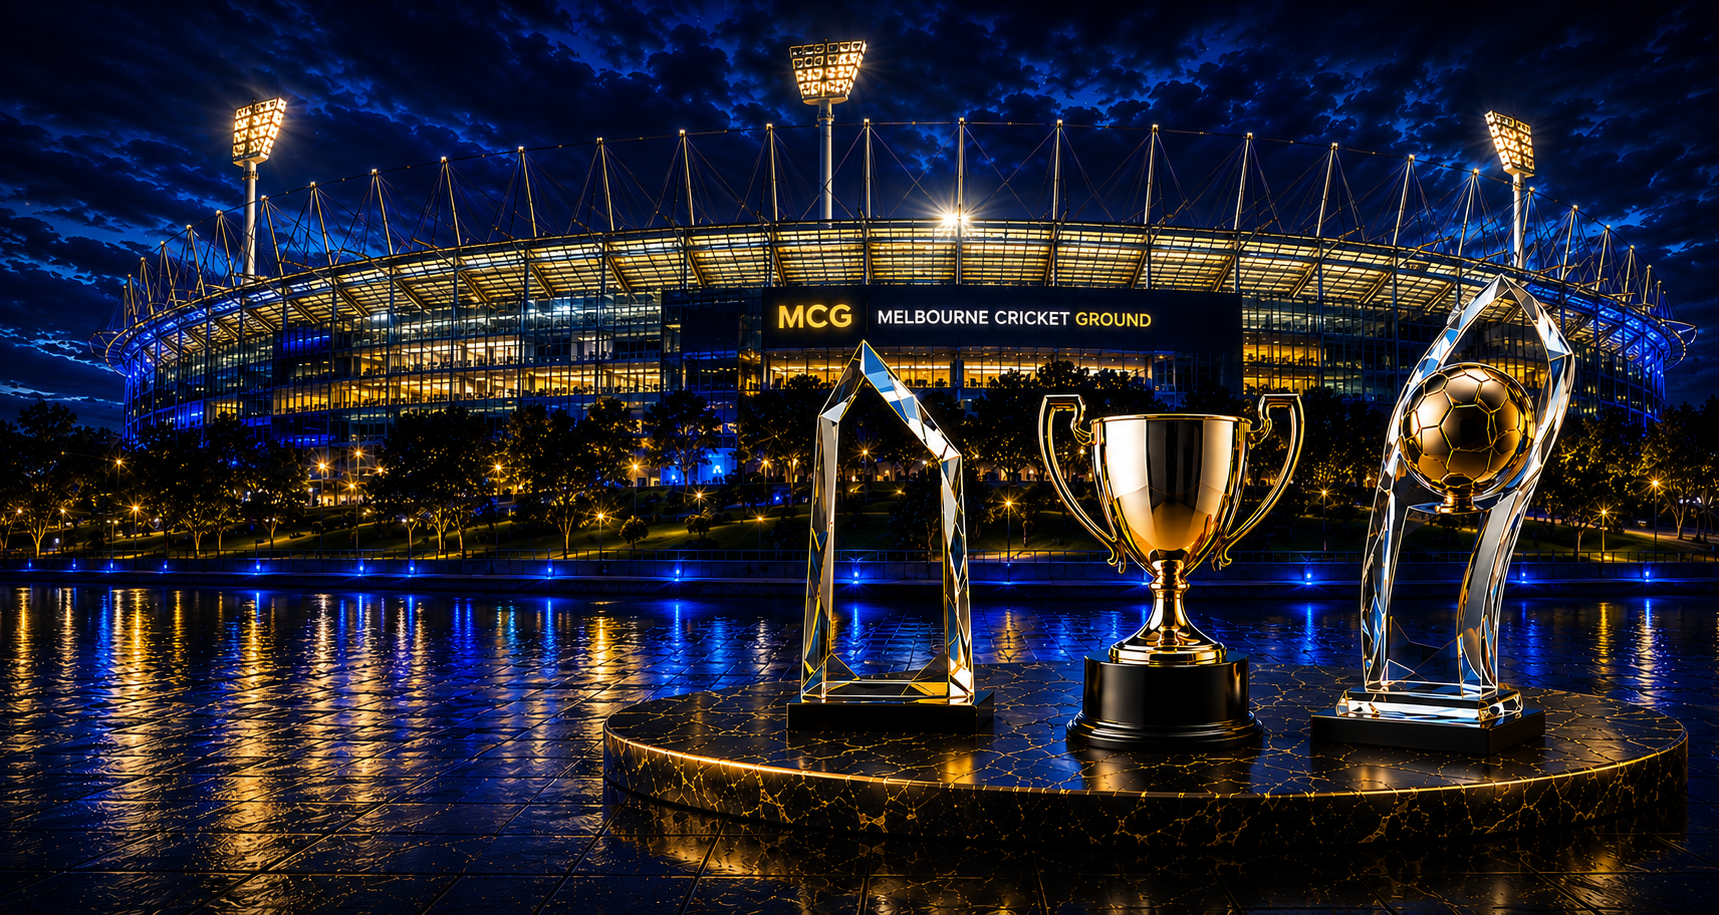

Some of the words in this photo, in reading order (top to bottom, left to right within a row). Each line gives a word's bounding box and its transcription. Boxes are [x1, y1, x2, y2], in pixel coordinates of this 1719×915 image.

[778, 304, 852, 328] MCG
[878, 309, 988, 325] MELBOURNE
[995, 310, 1070, 326] CRICKET
[1076, 311, 1151, 327] GROUND
